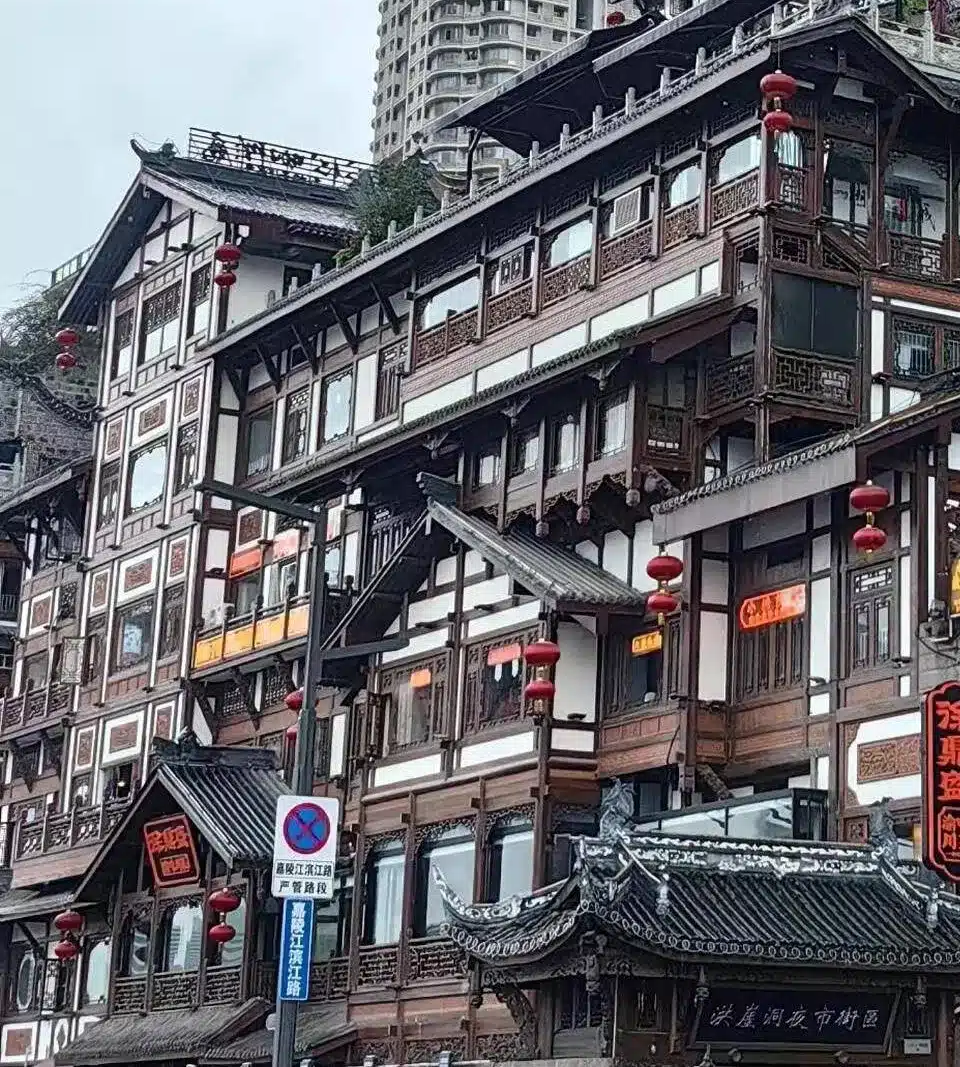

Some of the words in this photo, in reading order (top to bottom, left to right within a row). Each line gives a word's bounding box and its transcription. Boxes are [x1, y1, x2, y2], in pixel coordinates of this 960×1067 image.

[276, 861, 333, 877] 嘉陵江滨江路
[278, 881, 328, 895] 严管路段
[286, 901, 306, 998] 嘉陵江滨江路
